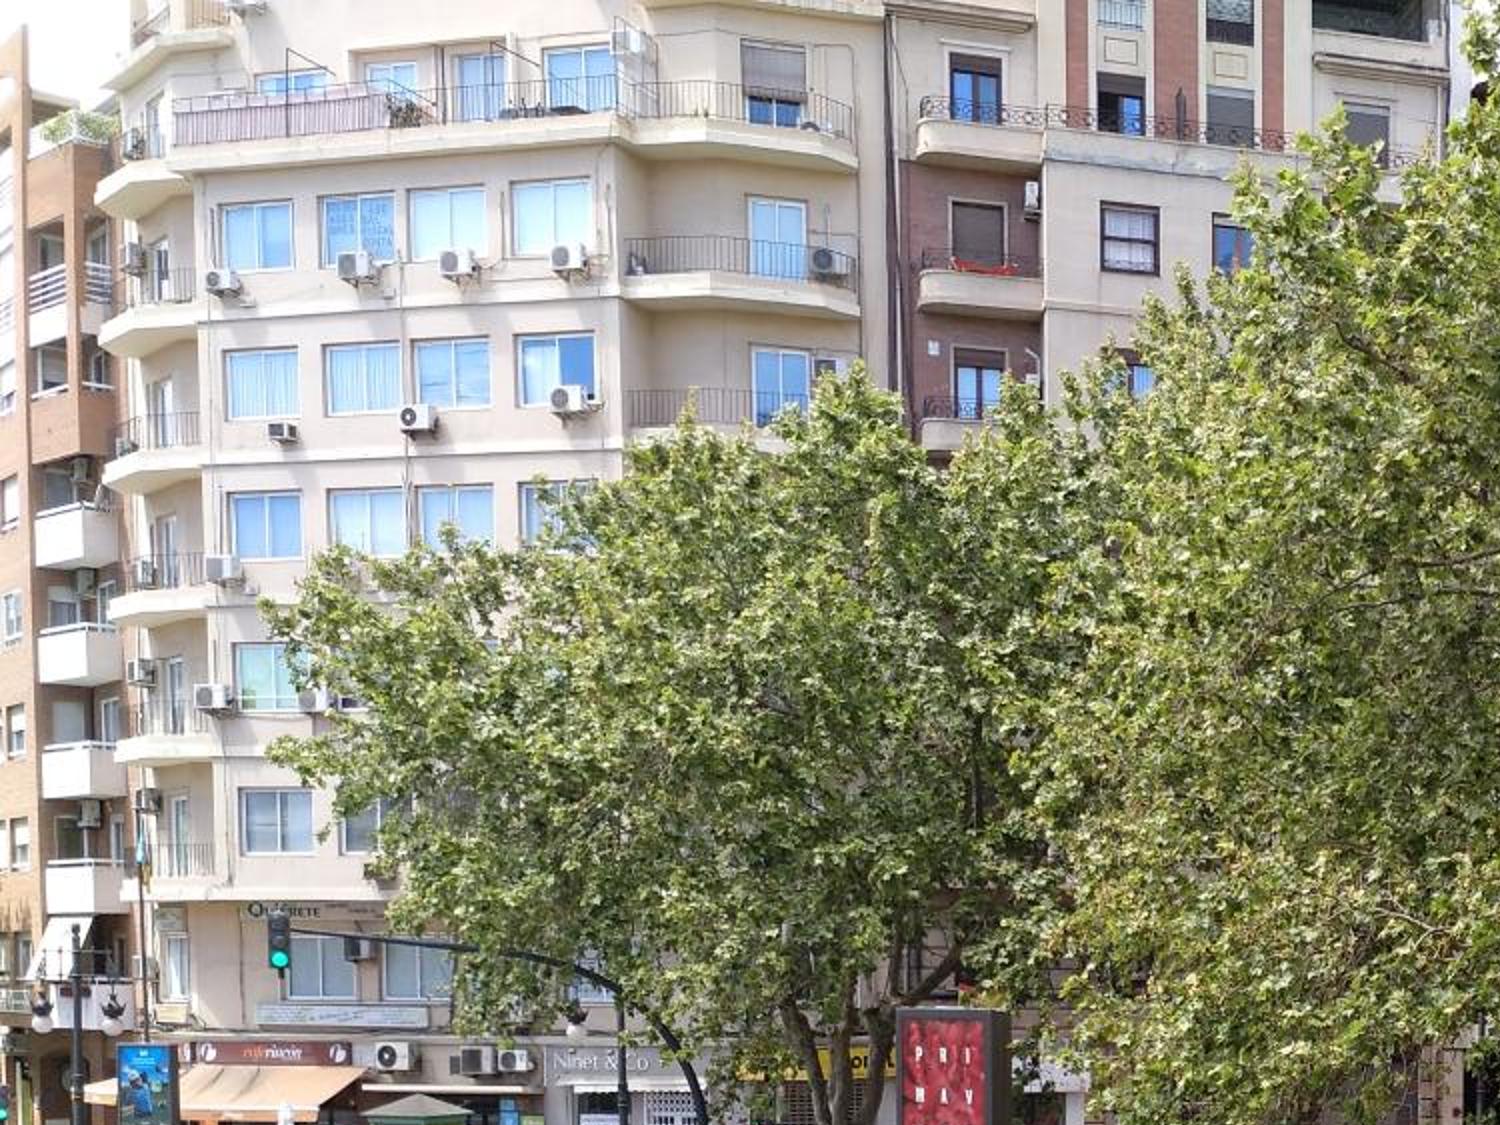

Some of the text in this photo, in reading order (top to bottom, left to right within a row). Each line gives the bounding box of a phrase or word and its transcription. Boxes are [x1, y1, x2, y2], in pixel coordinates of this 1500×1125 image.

[553, 1052, 598, 1070] Ninet
[605, 1052, 618, 1070] &
[915, 1047, 971, 1064] PRI
[915, 1088, 973, 1106] MAV
